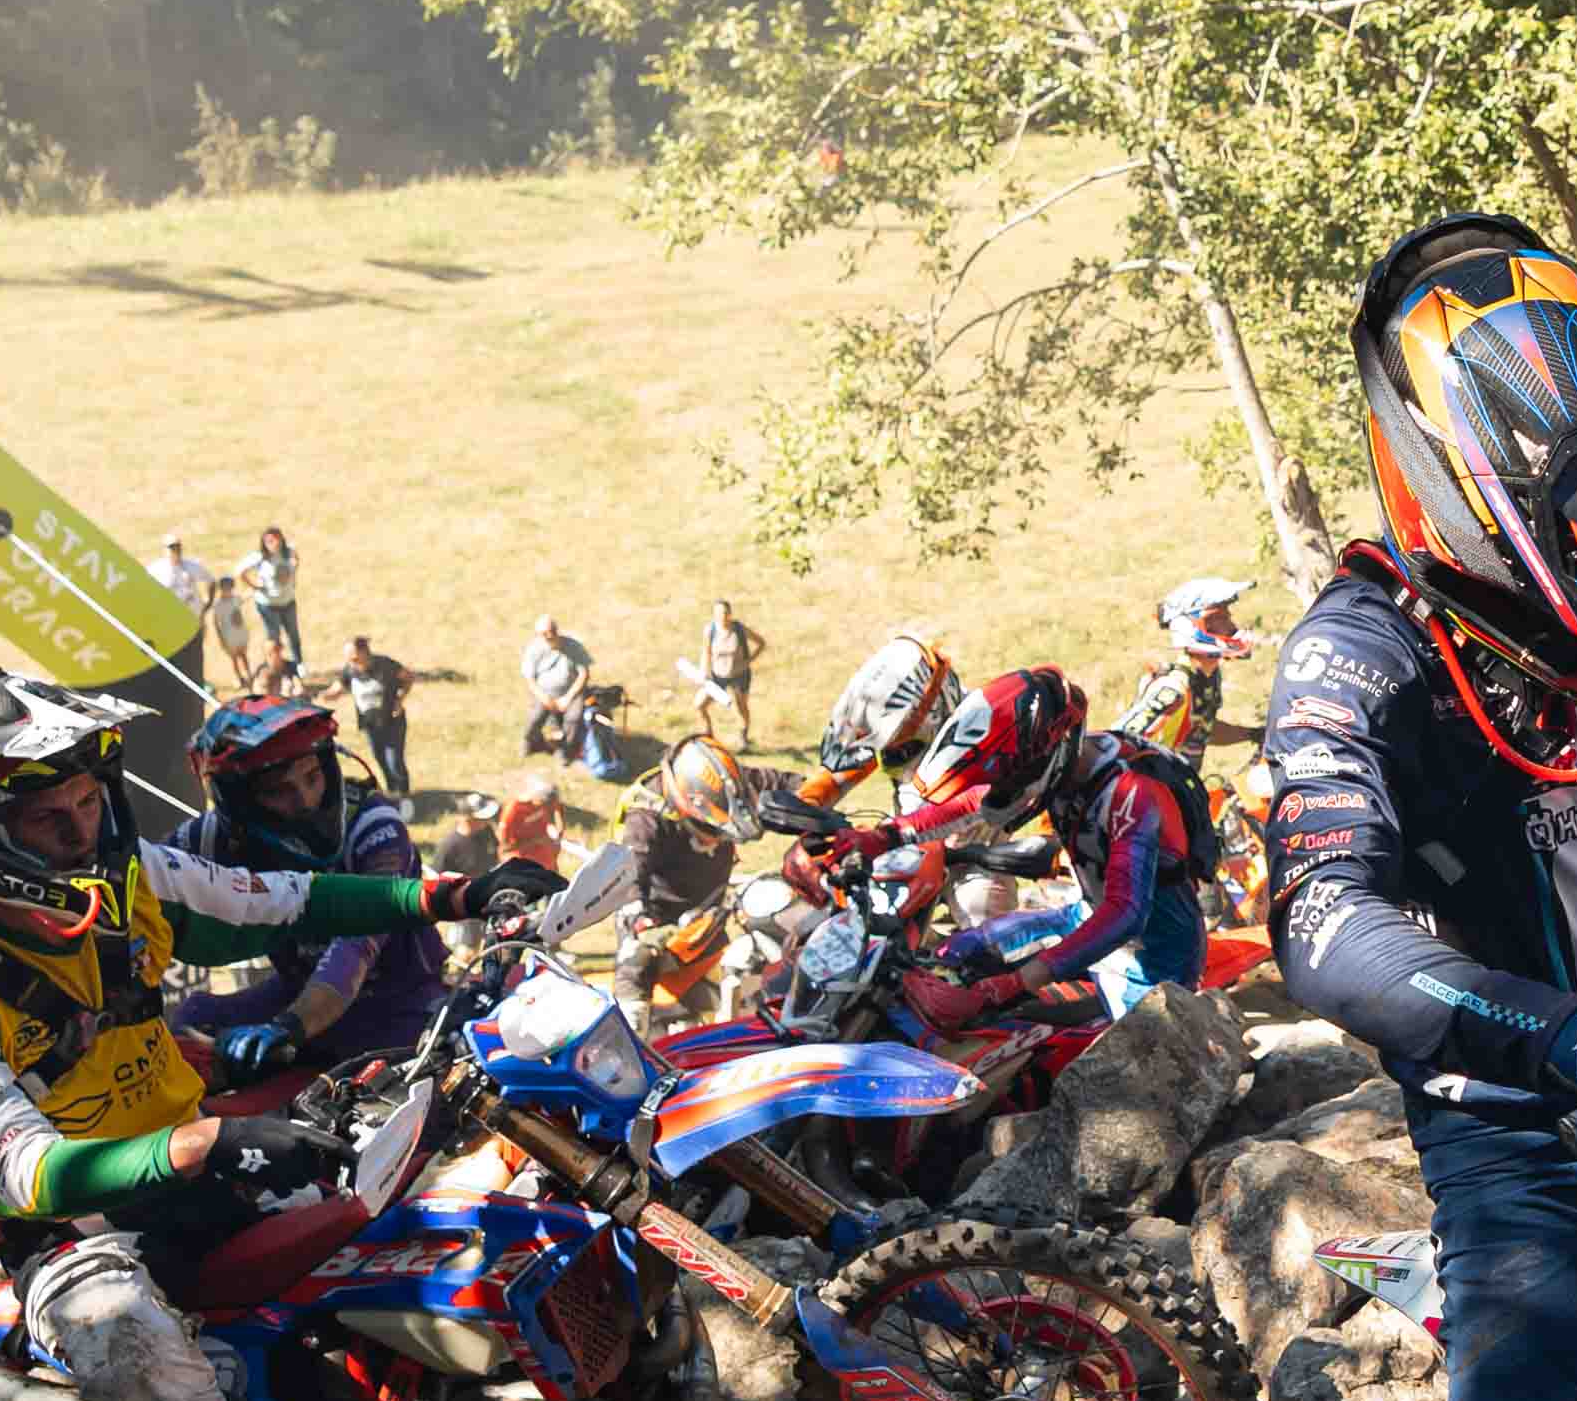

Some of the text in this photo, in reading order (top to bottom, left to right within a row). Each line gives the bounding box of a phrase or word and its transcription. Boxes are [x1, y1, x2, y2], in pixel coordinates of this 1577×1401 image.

[33, 509, 127, 592] STAY
[1326, 667, 1384, 698] synthetic
[1331, 654, 1400, 695] BALTIC
[1305, 793, 1367, 810] VIADA
